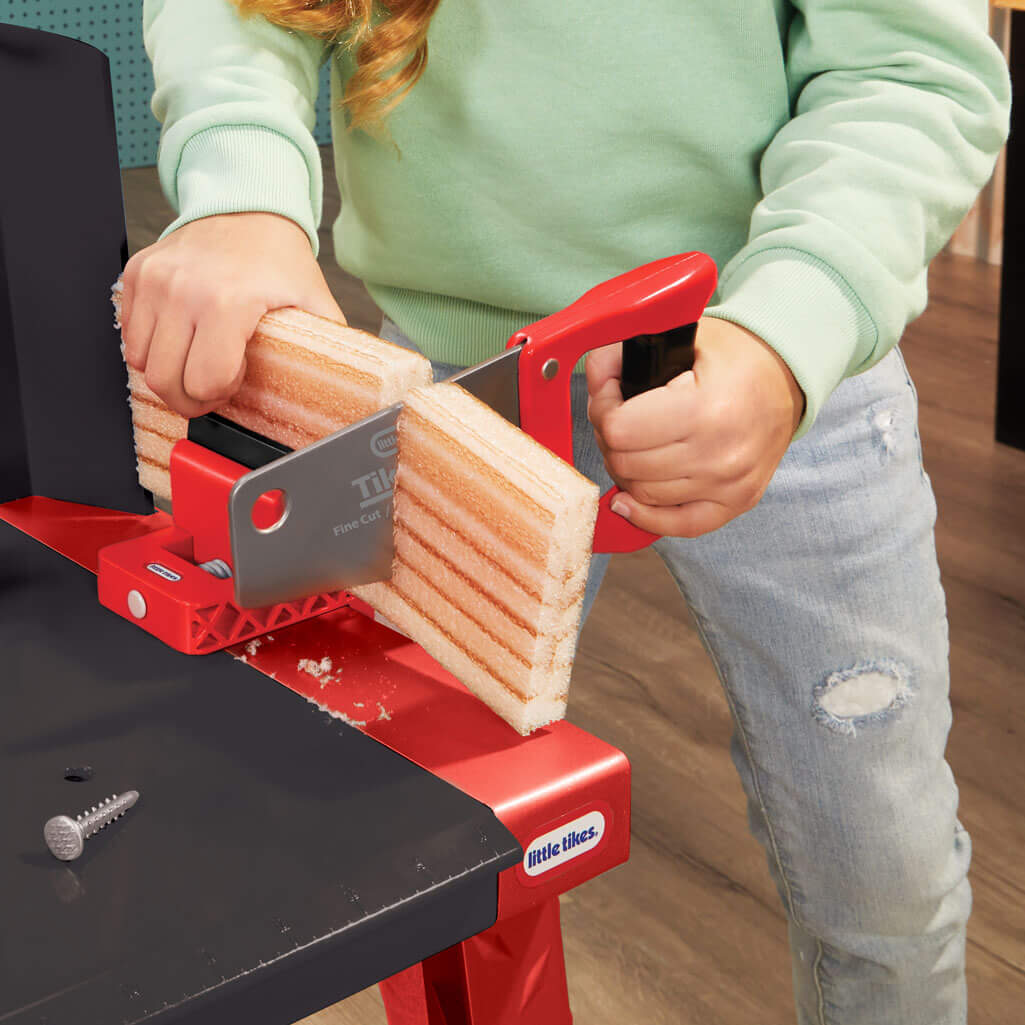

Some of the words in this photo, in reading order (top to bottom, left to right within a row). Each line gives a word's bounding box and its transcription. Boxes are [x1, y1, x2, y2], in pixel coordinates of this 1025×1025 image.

[333, 519, 359, 536] Fine
[360, 509, 382, 524] Cut
[527, 842, 560, 869] little
